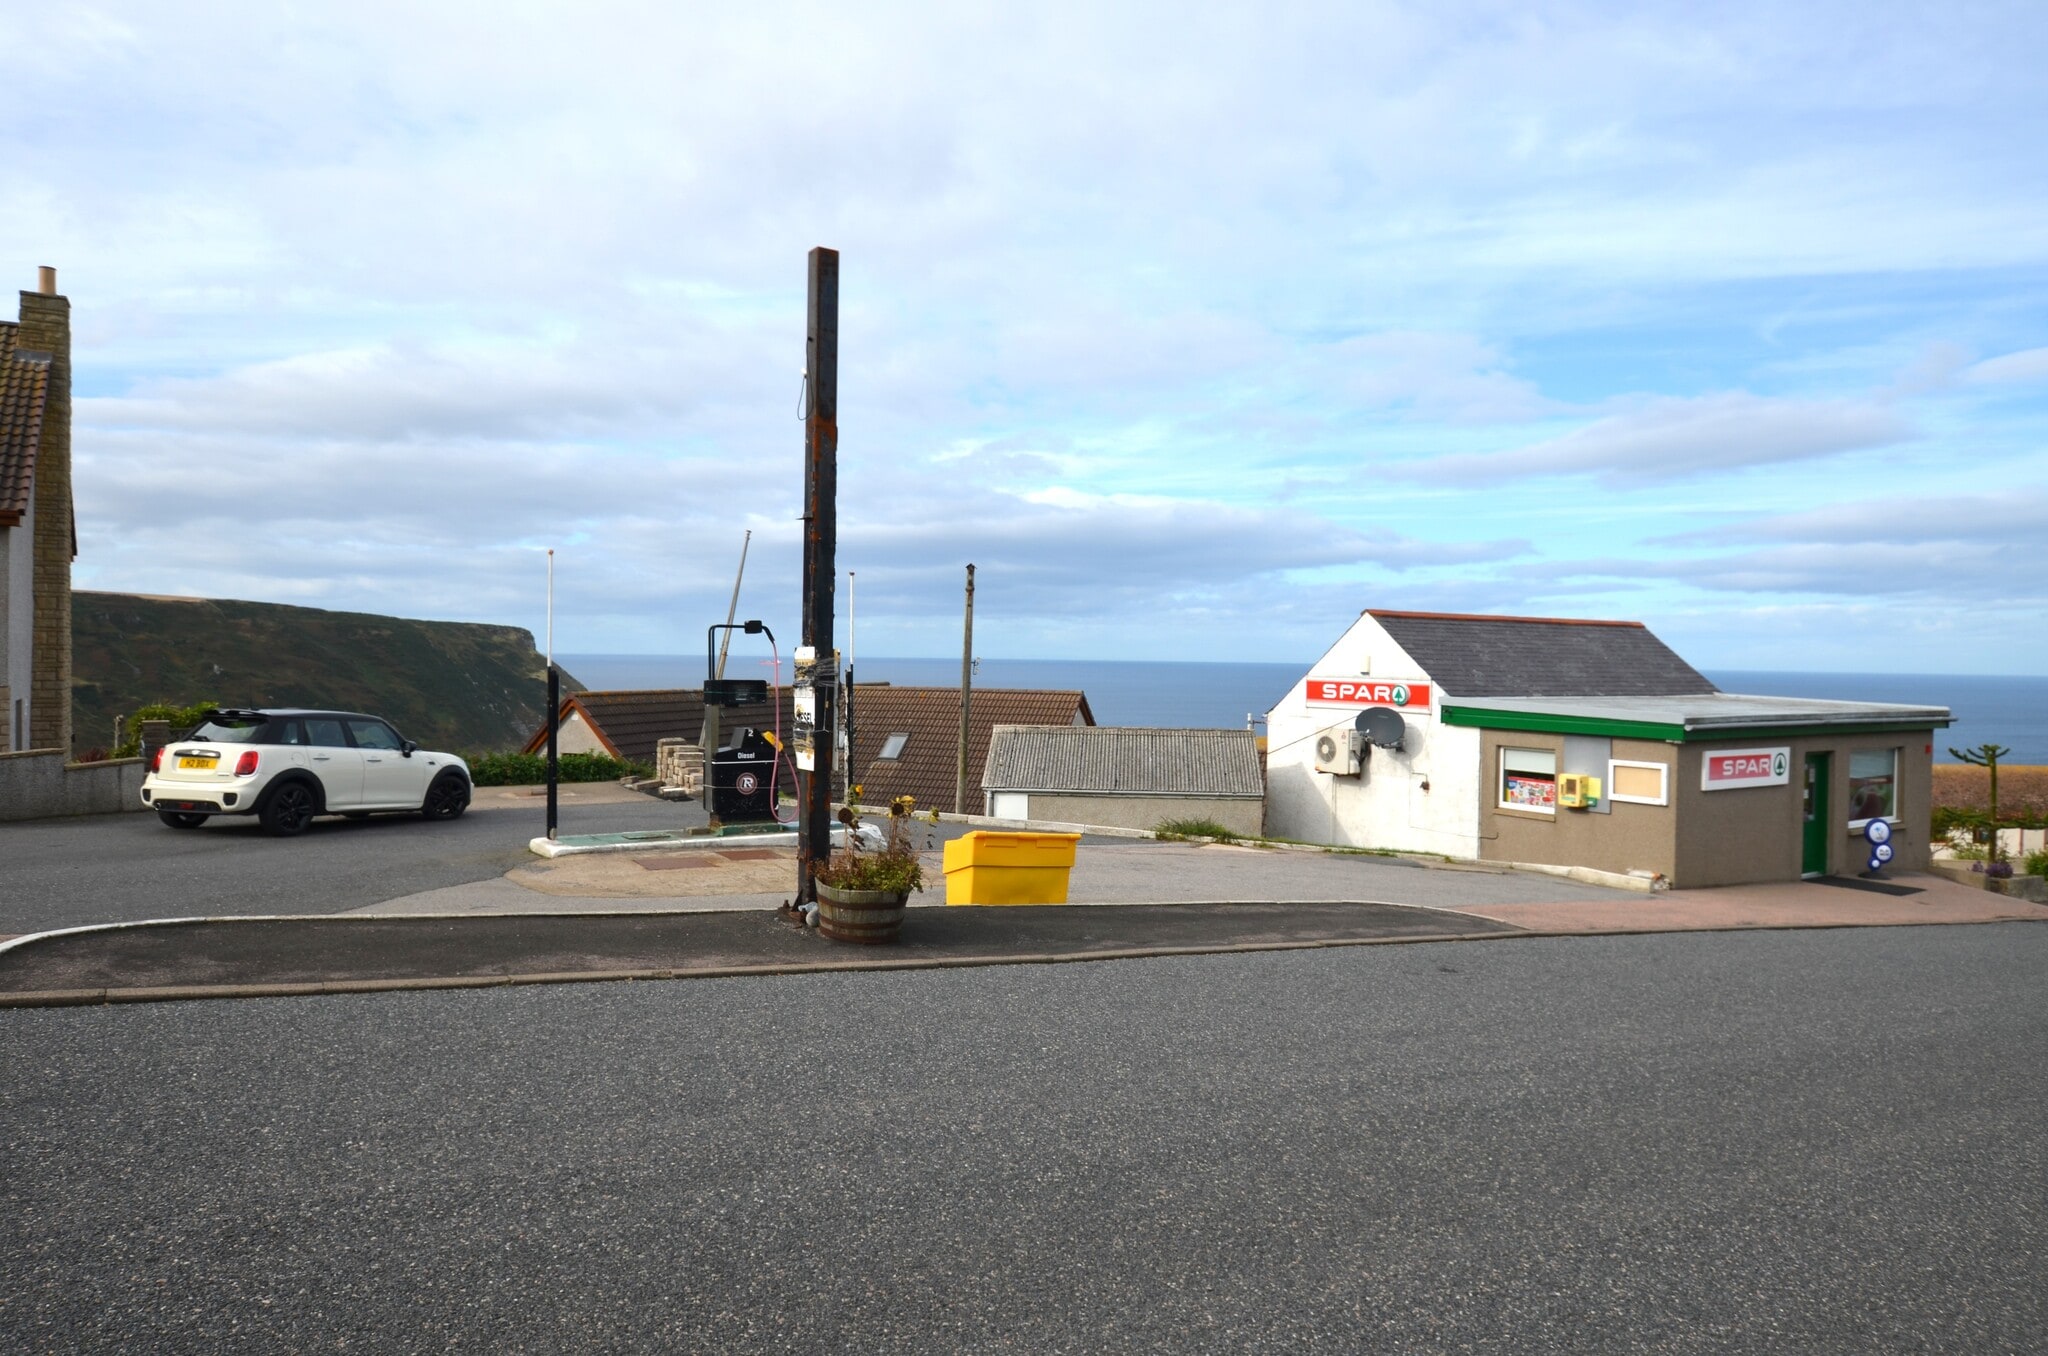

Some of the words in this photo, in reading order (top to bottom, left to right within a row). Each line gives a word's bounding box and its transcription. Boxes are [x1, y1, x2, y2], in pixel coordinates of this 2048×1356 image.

[1322, 683, 1391, 701] SPAR
[748, 729, 754, 737] 2
[1723, 758, 1769, 776] SPAR
